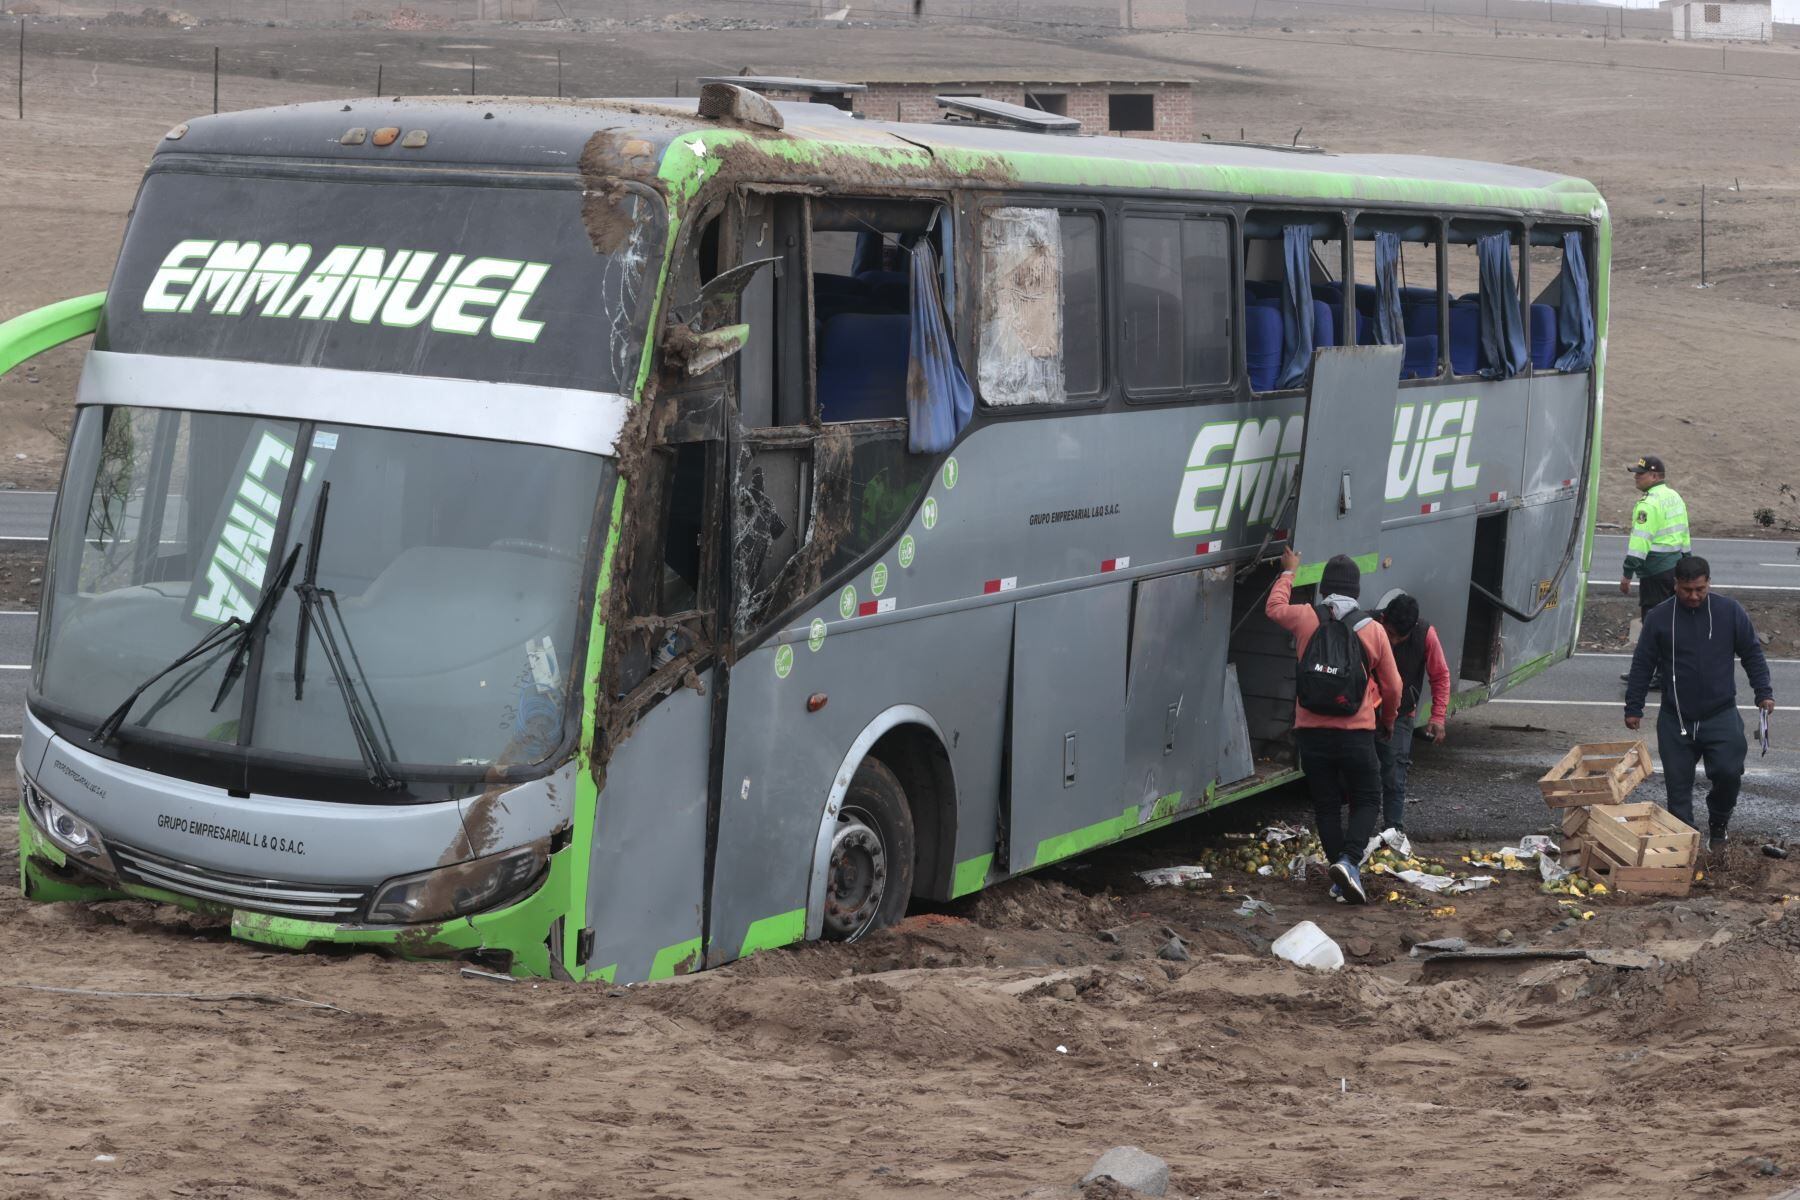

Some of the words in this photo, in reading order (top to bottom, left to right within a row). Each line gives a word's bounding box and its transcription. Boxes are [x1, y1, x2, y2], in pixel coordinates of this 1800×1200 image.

[142, 239, 552, 343] EMMANUEL
[1029, 513, 1050, 526] GRUPO
[1051, 507, 1090, 523] EMPRESARIAL
[1314, 663, 1338, 675] Mobil
[157, 814, 188, 832] GRUPO
[189, 820, 251, 846] EMPRESARIAL
[253, 833, 259, 847] L
[261, 834, 268, 848] &
[270, 836, 278, 851] Q
[279, 838, 306, 855] S.A.C.
